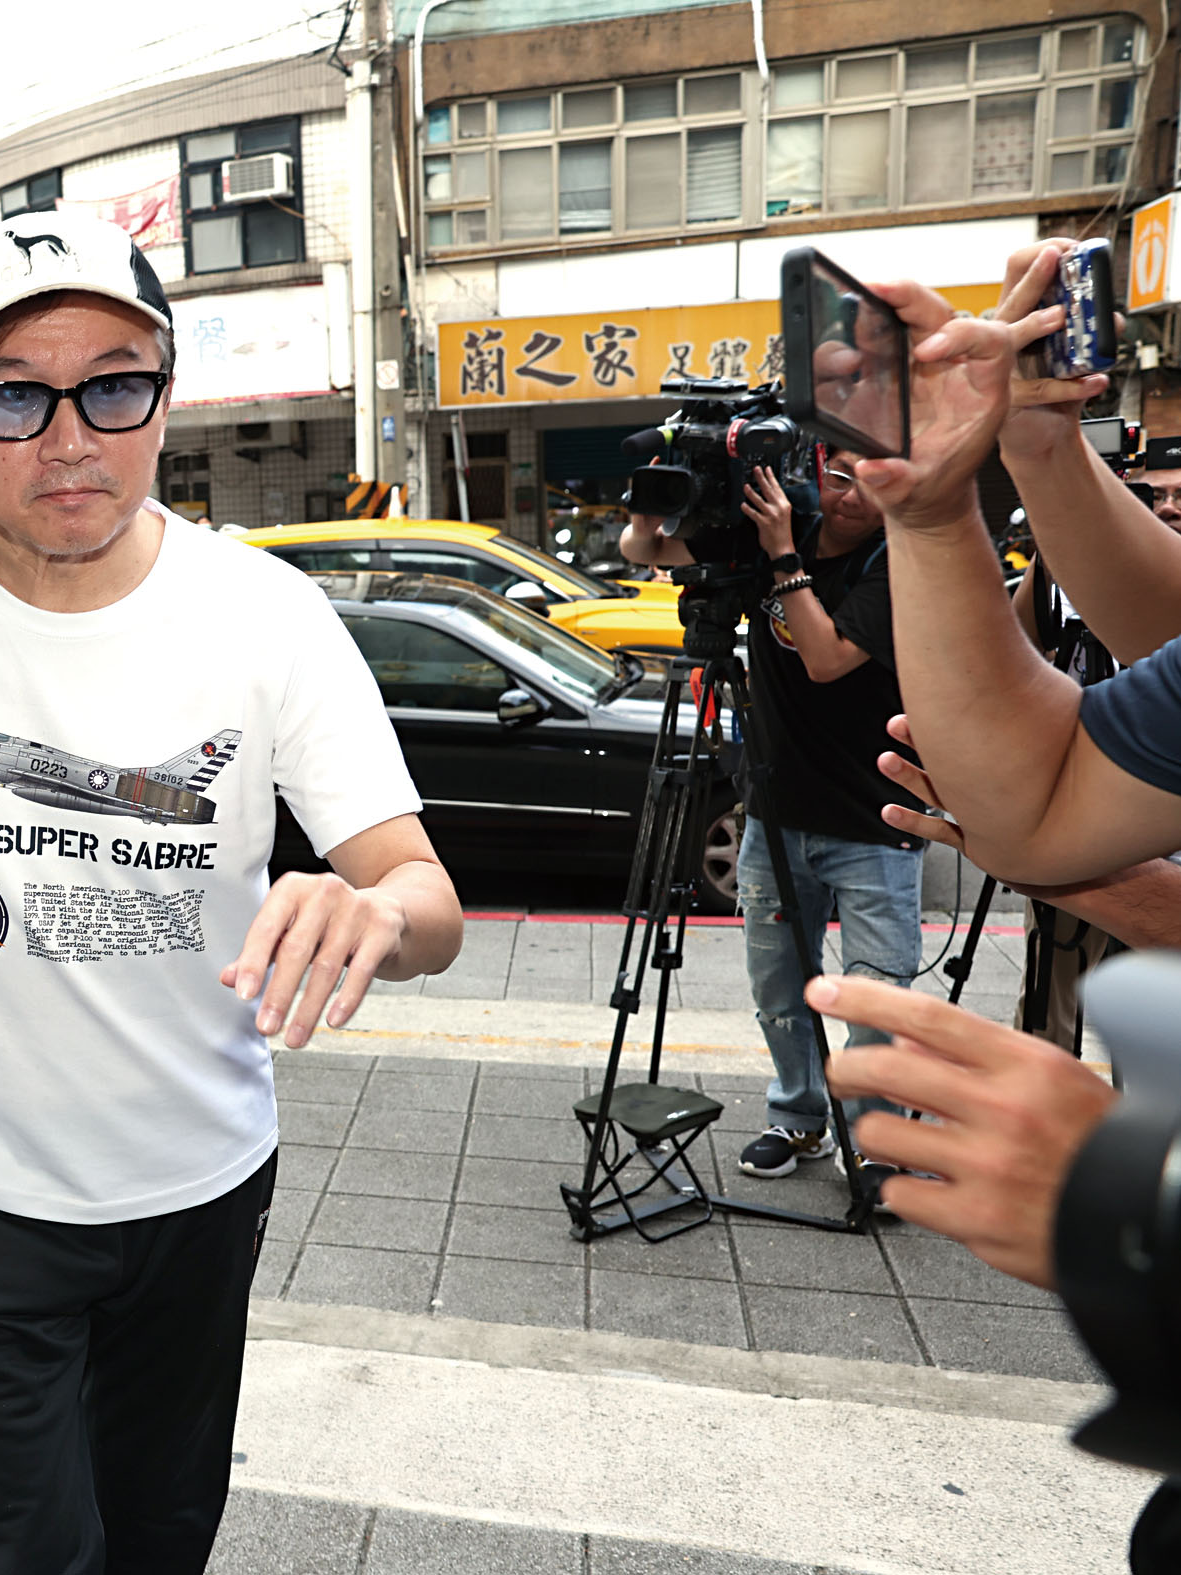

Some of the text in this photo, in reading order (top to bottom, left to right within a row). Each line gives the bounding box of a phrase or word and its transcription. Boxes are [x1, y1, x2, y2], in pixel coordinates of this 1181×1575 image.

[461, 324, 637, 397] 蘭之家
[30, 758, 68, 779] 0223
[111, 838, 217, 870] SABRE
[71, 885, 106, 894] American
[135, 889, 157, 898] Super
[41, 898, 66, 906] United
[69, 892, 82, 900] jet
[83, 893, 112, 901] fighter
[149, 897, 167, 906] that
[59, 906, 76, 914] with
[111, 908, 144, 916] National
[147, 908, 169, 916] Guard
[60, 920, 71, 928] jet
[170, 922, 189, 930] first
[111, 916, 142, 924] Century
[25, 926, 53, 934] fighter
[105, 930, 147, 938] supersonic
[152, 927, 171, 935] speed
[27, 938, 45, 948] North
[117, 936, 159, 944] originally
[163, 933, 195, 941] designed
[27, 944, 71, 956] performance
[170, 944, 189, 952] Sabre
[27, 950, 69, 963] superiority
